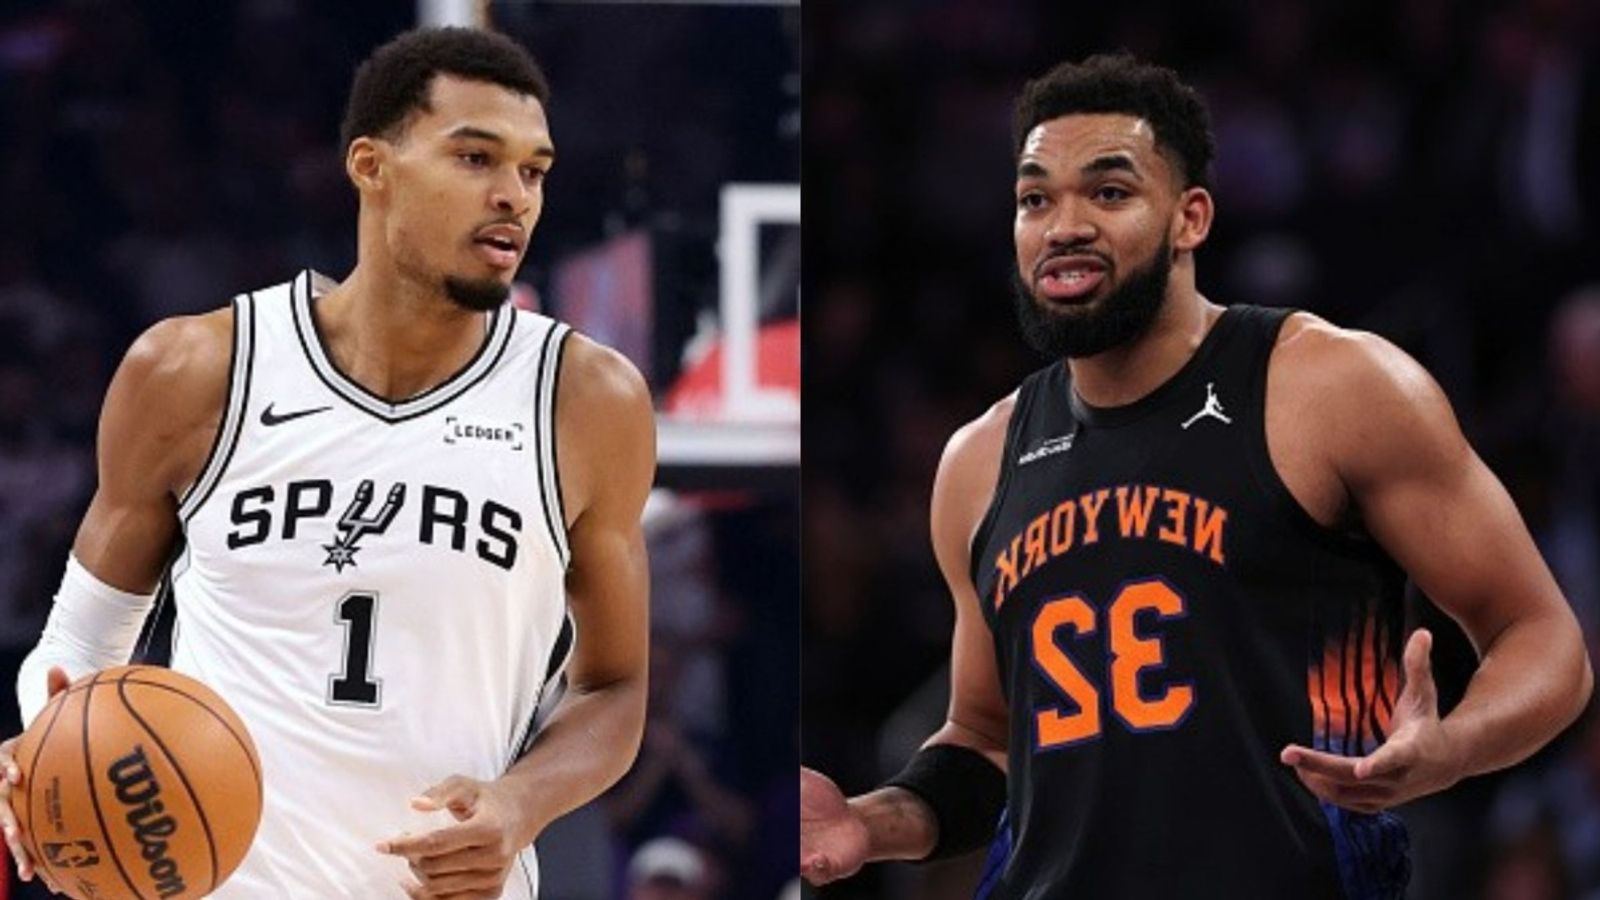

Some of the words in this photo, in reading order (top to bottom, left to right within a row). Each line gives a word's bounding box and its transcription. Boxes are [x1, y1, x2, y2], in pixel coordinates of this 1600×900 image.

[454, 424, 514, 441] LEDGER
[227, 479, 523, 573] SPURS
[326, 590, 382, 709] 1
[107, 744, 187, 900] Wilson
